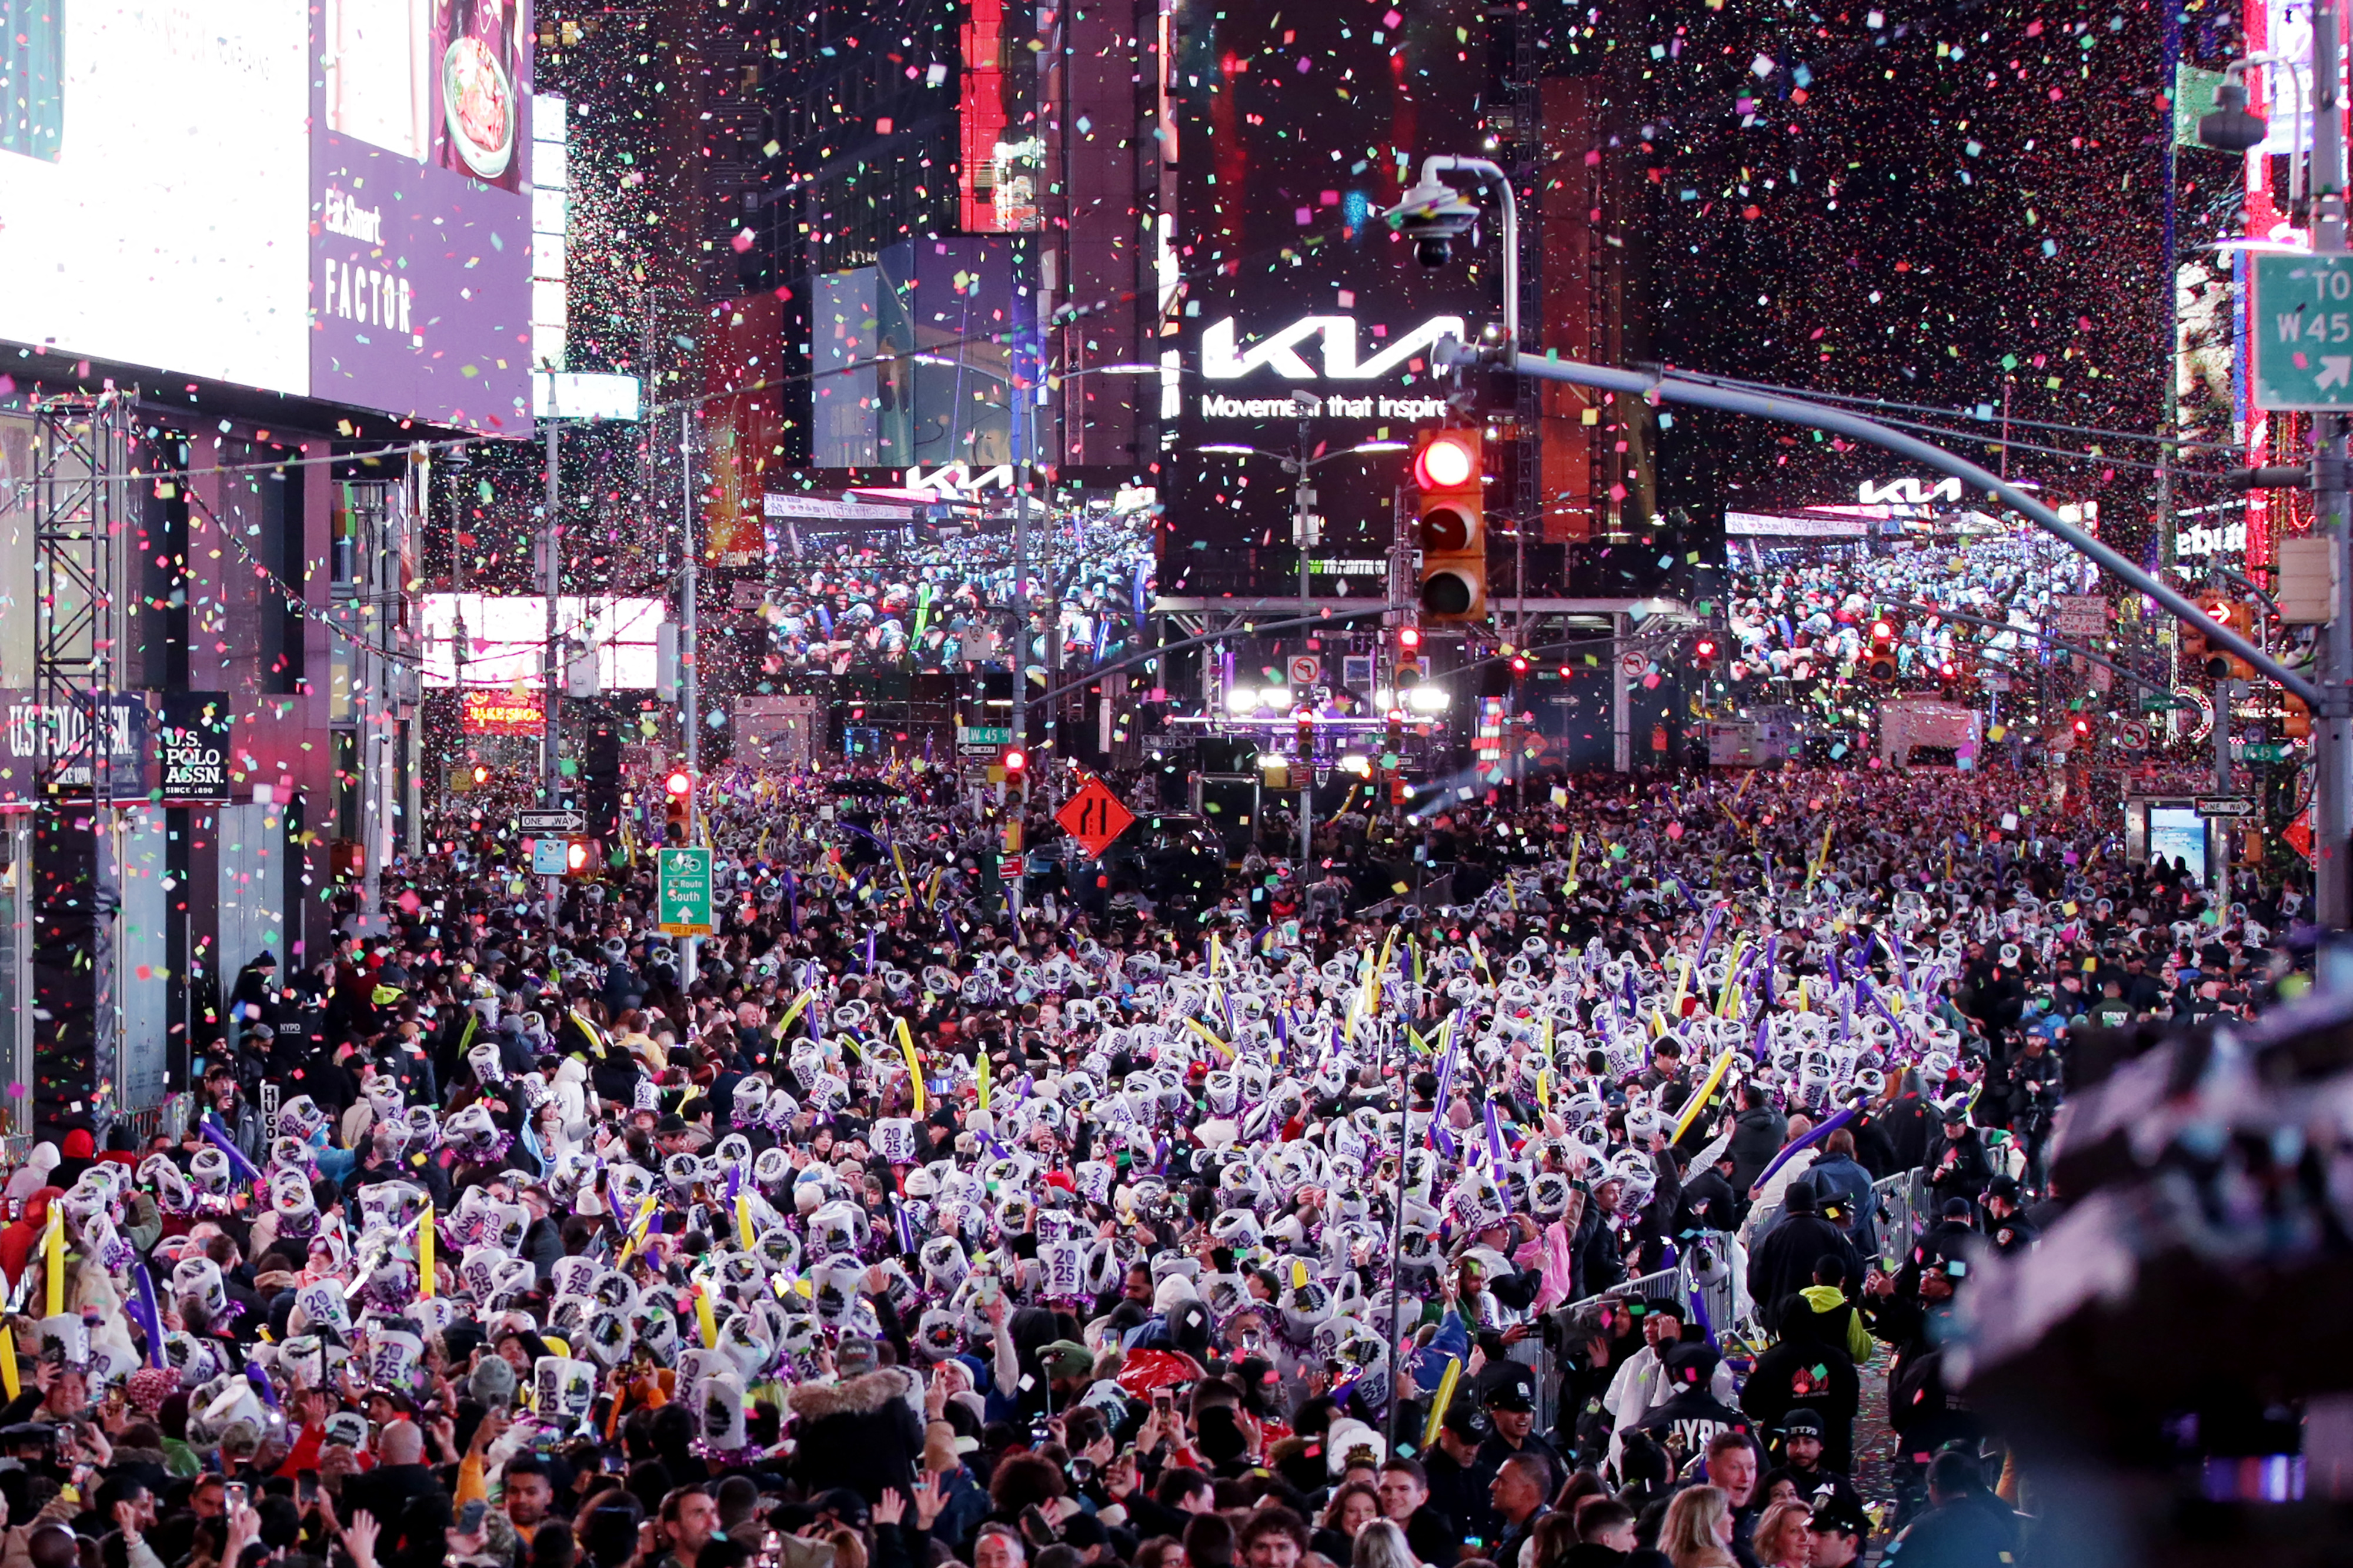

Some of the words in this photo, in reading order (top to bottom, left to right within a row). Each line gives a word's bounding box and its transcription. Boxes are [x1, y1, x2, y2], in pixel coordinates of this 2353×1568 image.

[326, 188, 345, 235] Eat
[2312, 270, 2351, 300] TO
[326, 258, 410, 333] FACTOR
[1327, 394, 1373, 417] that
[970, 730, 980, 741] W
[984, 729, 997, 741] 45
[166, 749, 220, 765] POLO
[165, 766, 224, 784] ASSN.
[2204, 803, 2220, 811] ONE
[2229, 803, 2247, 811] WAY
[524, 817, 543, 825] ONE
[554, 817, 575, 825] WAY
[680, 880, 703, 888] Route
[670, 891, 700, 902] South
[1185, 995, 1199, 1008] 20
[1180, 1004, 1194, 1016] 25
[280, 1023, 301, 1031] NYPD
[1113, 1032, 1128, 1045] 20
[1149, 1032, 1164, 1042] 20
[1109, 1041, 1124, 1054] 25
[1606, 1049, 1620, 1063] 20
[1841, 1057, 1855, 1067] 20
[477, 1062, 493, 1073] 20
[794, 1064, 809, 1078] 20
[1612, 1061, 1625, 1074] 25
[481, 1071, 497, 1081] 25
[799, 1075, 815, 1086] 25
[523, 1079, 538, 1091] 20
[638, 1083, 652, 1094] 20
[819, 1077, 833, 1090] 20
[1805, 1084, 1822, 1094] 20
[637, 1094, 651, 1105] 25
[1805, 1094, 1820, 1104] 25
[265, 1088, 276, 1139] HUGO
[1563, 1109, 1581, 1121] 20
[280, 1114, 296, 1132] 20
[1566, 1121, 1581, 1132] 25
[883, 1127, 900, 1141] 20
[884, 1141, 901, 1154] 25
[1093, 1167, 1109, 1181] 20
[965, 1182, 982, 1203] 20
[364, 1201, 385, 1212] 20
[1456, 1193, 1473, 1209] 20
[486, 1210, 500, 1227] 20
[1466, 1208, 1482, 1227] 25
[483, 1225, 498, 1242] 25
[1054, 1248, 1076, 1265] 20
[465, 1262, 488, 1282] 20
[570, 1264, 593, 1283] 20
[1054, 1265, 1076, 1282] 25
[472, 1276, 493, 1297] 25
[565, 1279, 588, 1295] 25
[304, 1289, 328, 1312] 20
[1313, 1329, 1336, 1351] 20
[377, 1343, 403, 1360] 20
[375, 1360, 399, 1379] 25
[680, 1353, 700, 1377] 20
[538, 1370, 558, 1390] 20
[1361, 1372, 1384, 1392] 20
[537, 1391, 559, 1411] 25
[1363, 1385, 1386, 1403] 25
[1790, 1426, 1818, 1436] NYPD
